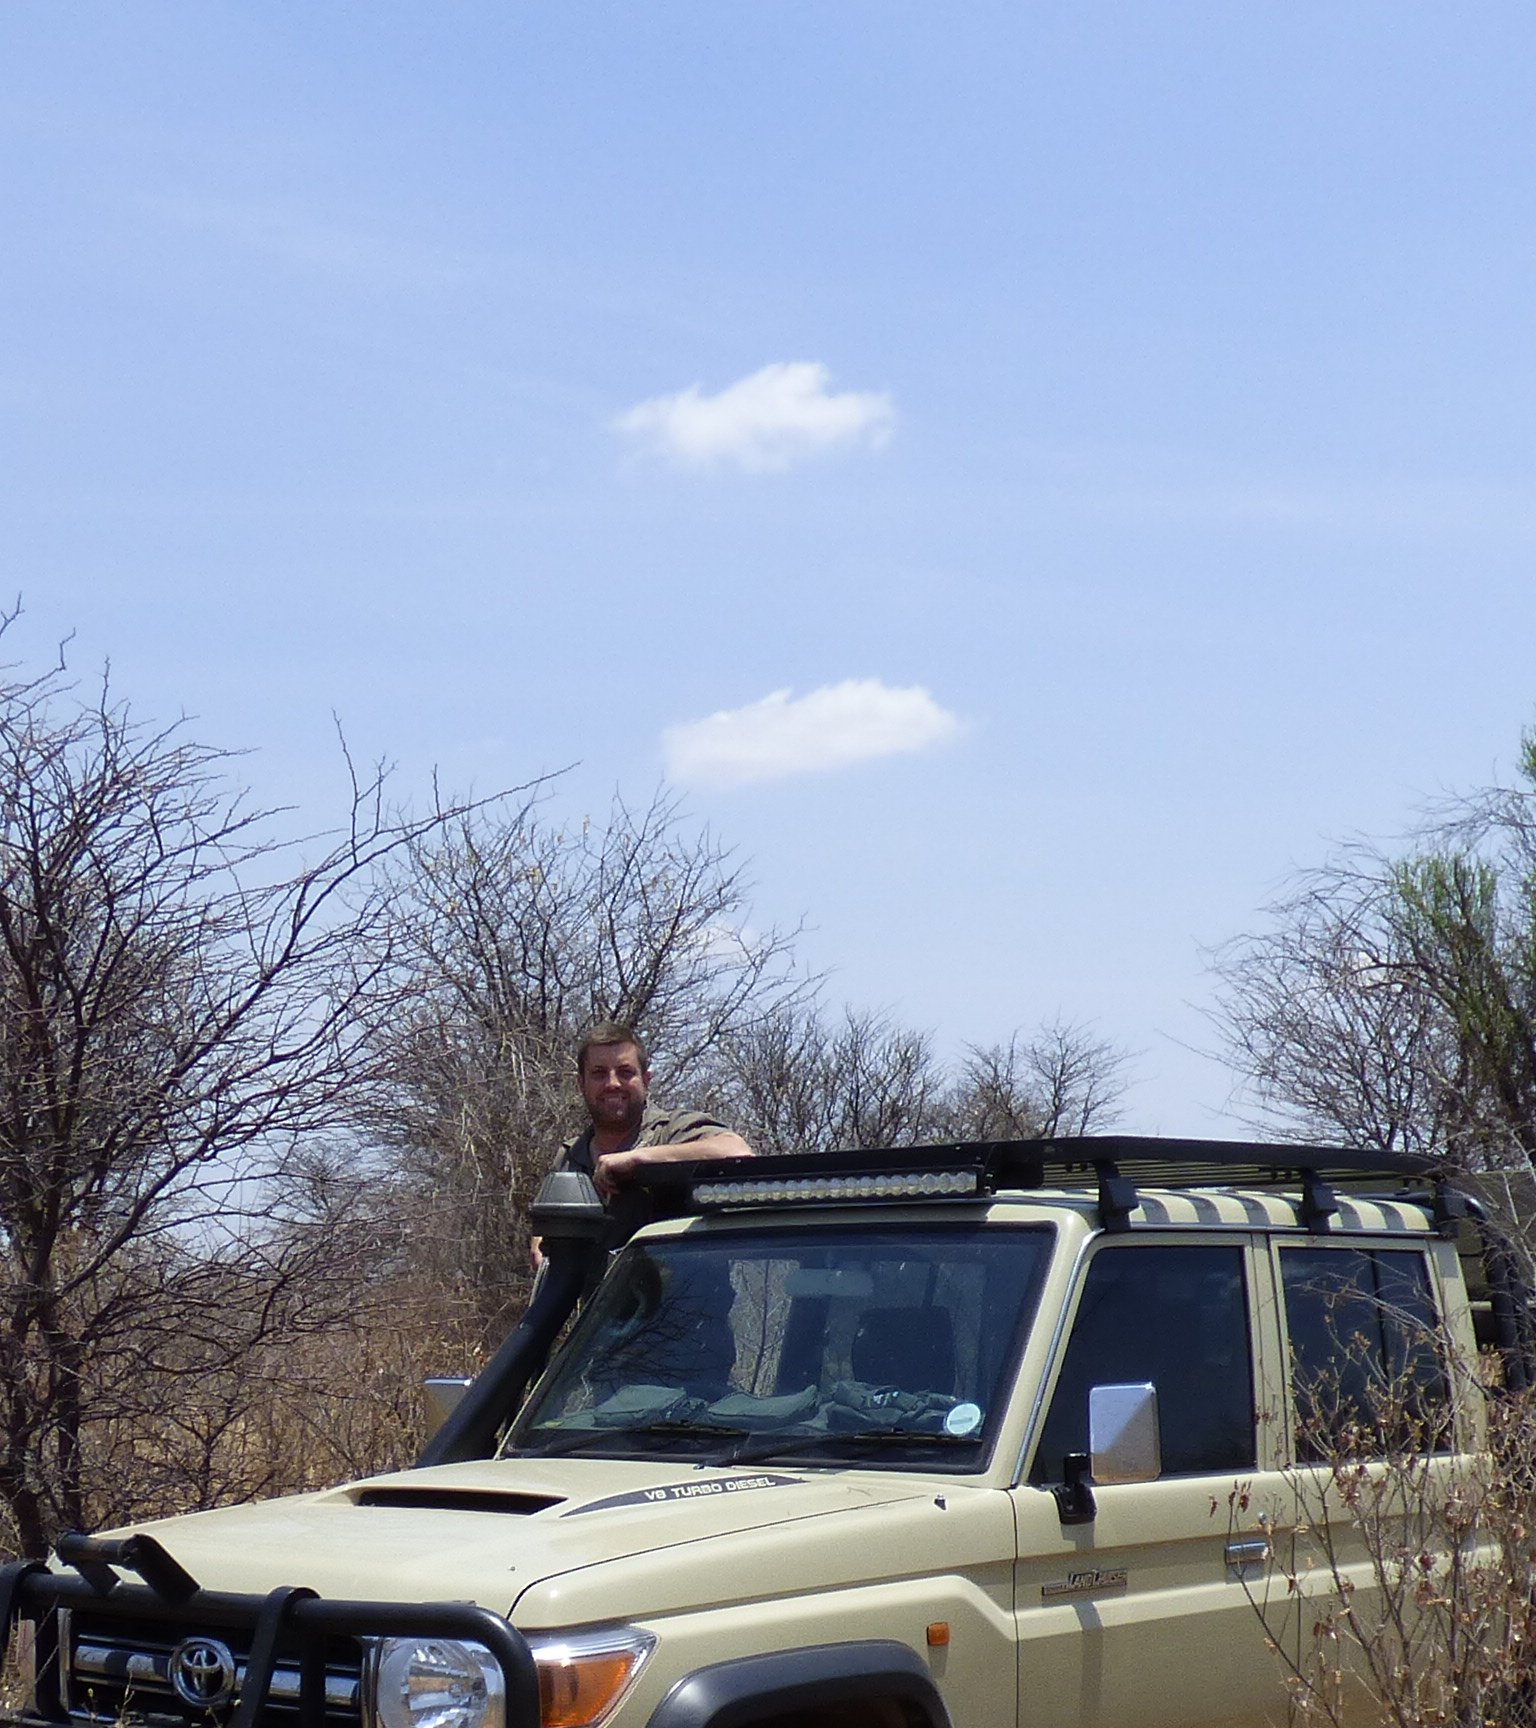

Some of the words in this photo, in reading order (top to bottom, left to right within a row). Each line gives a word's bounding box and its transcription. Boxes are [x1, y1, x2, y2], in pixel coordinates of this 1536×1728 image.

[644, 1489, 667, 1501] V8
[670, 1483, 723, 1499] TURBO
[725, 1476, 776, 1492] DIESEL
